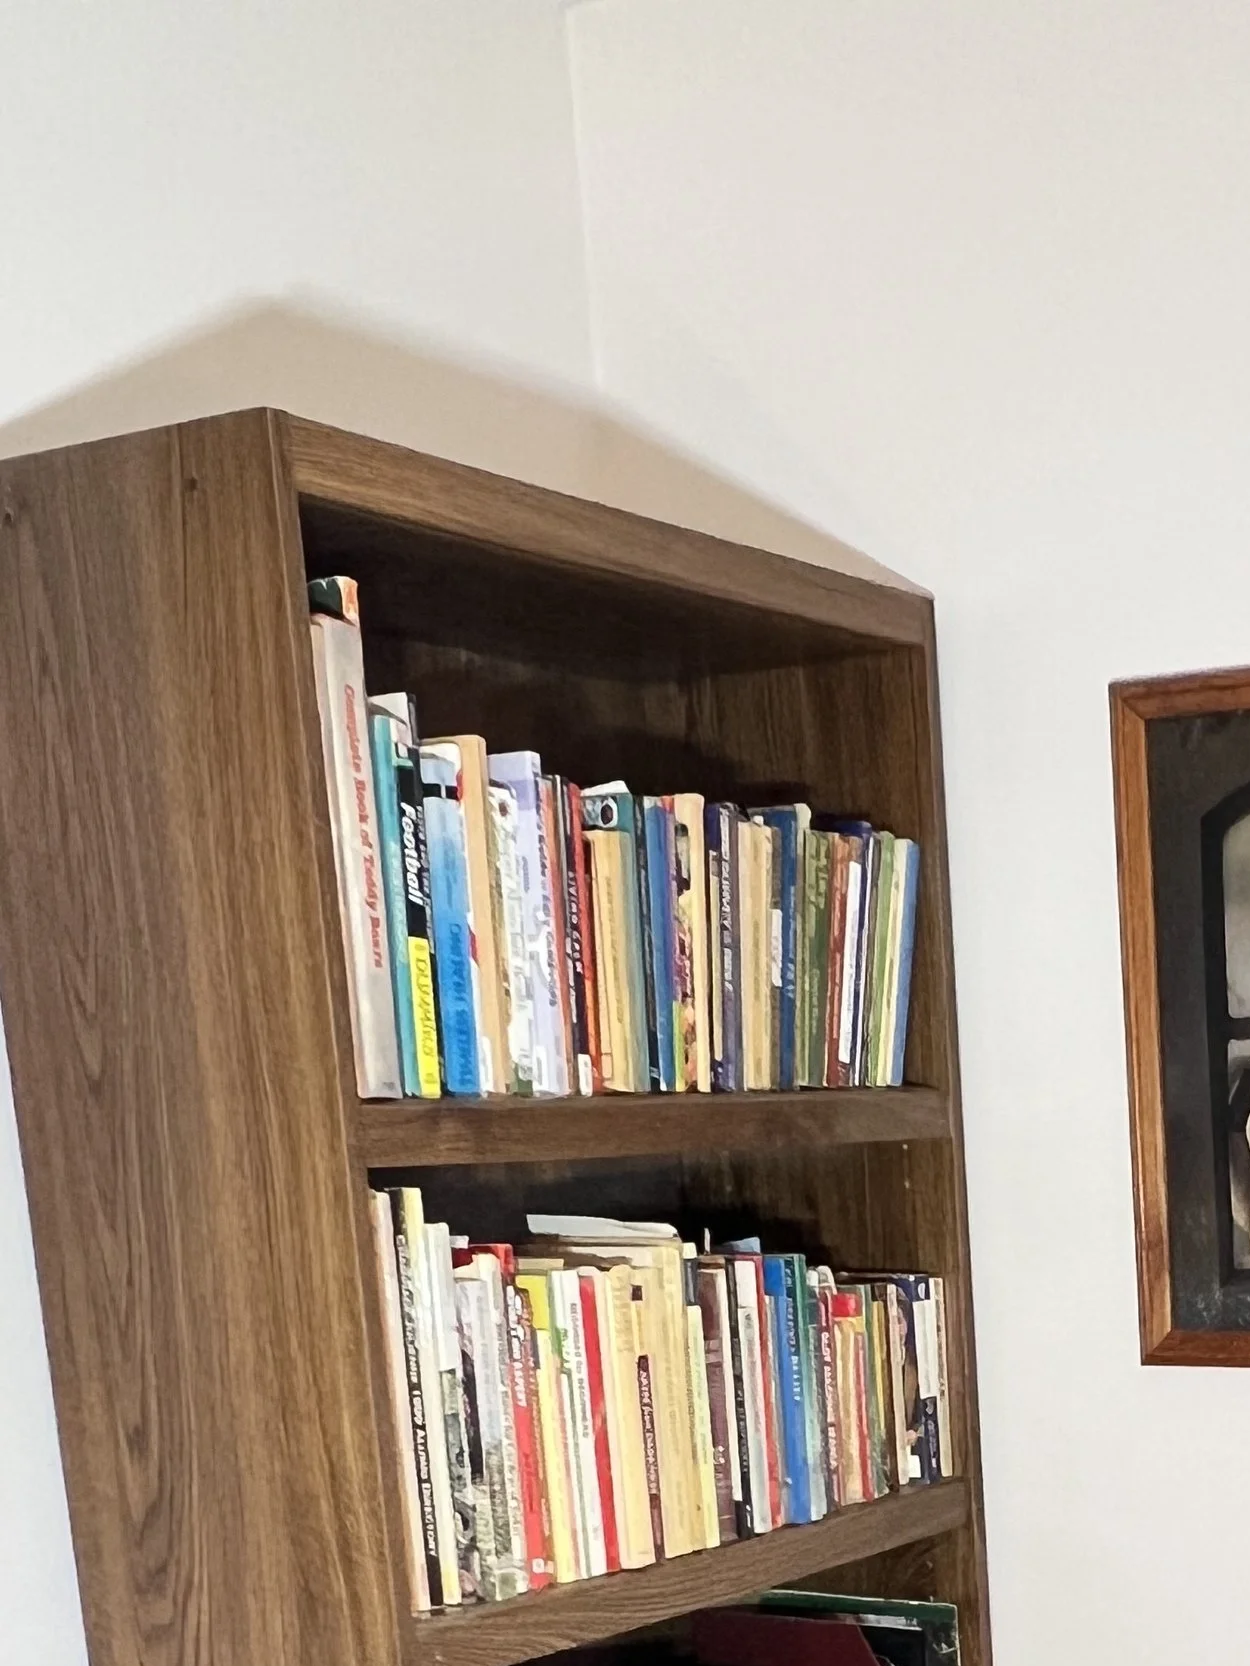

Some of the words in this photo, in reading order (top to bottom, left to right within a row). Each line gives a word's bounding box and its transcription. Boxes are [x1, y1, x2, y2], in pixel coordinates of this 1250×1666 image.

[344, 684, 363, 774] Complete
[353, 777, 369, 825] Book
[360, 828, 374, 850] of
[401, 802, 424, 905] Football
[363, 854, 378, 913] Teddy
[369, 916, 383, 968] Bears
